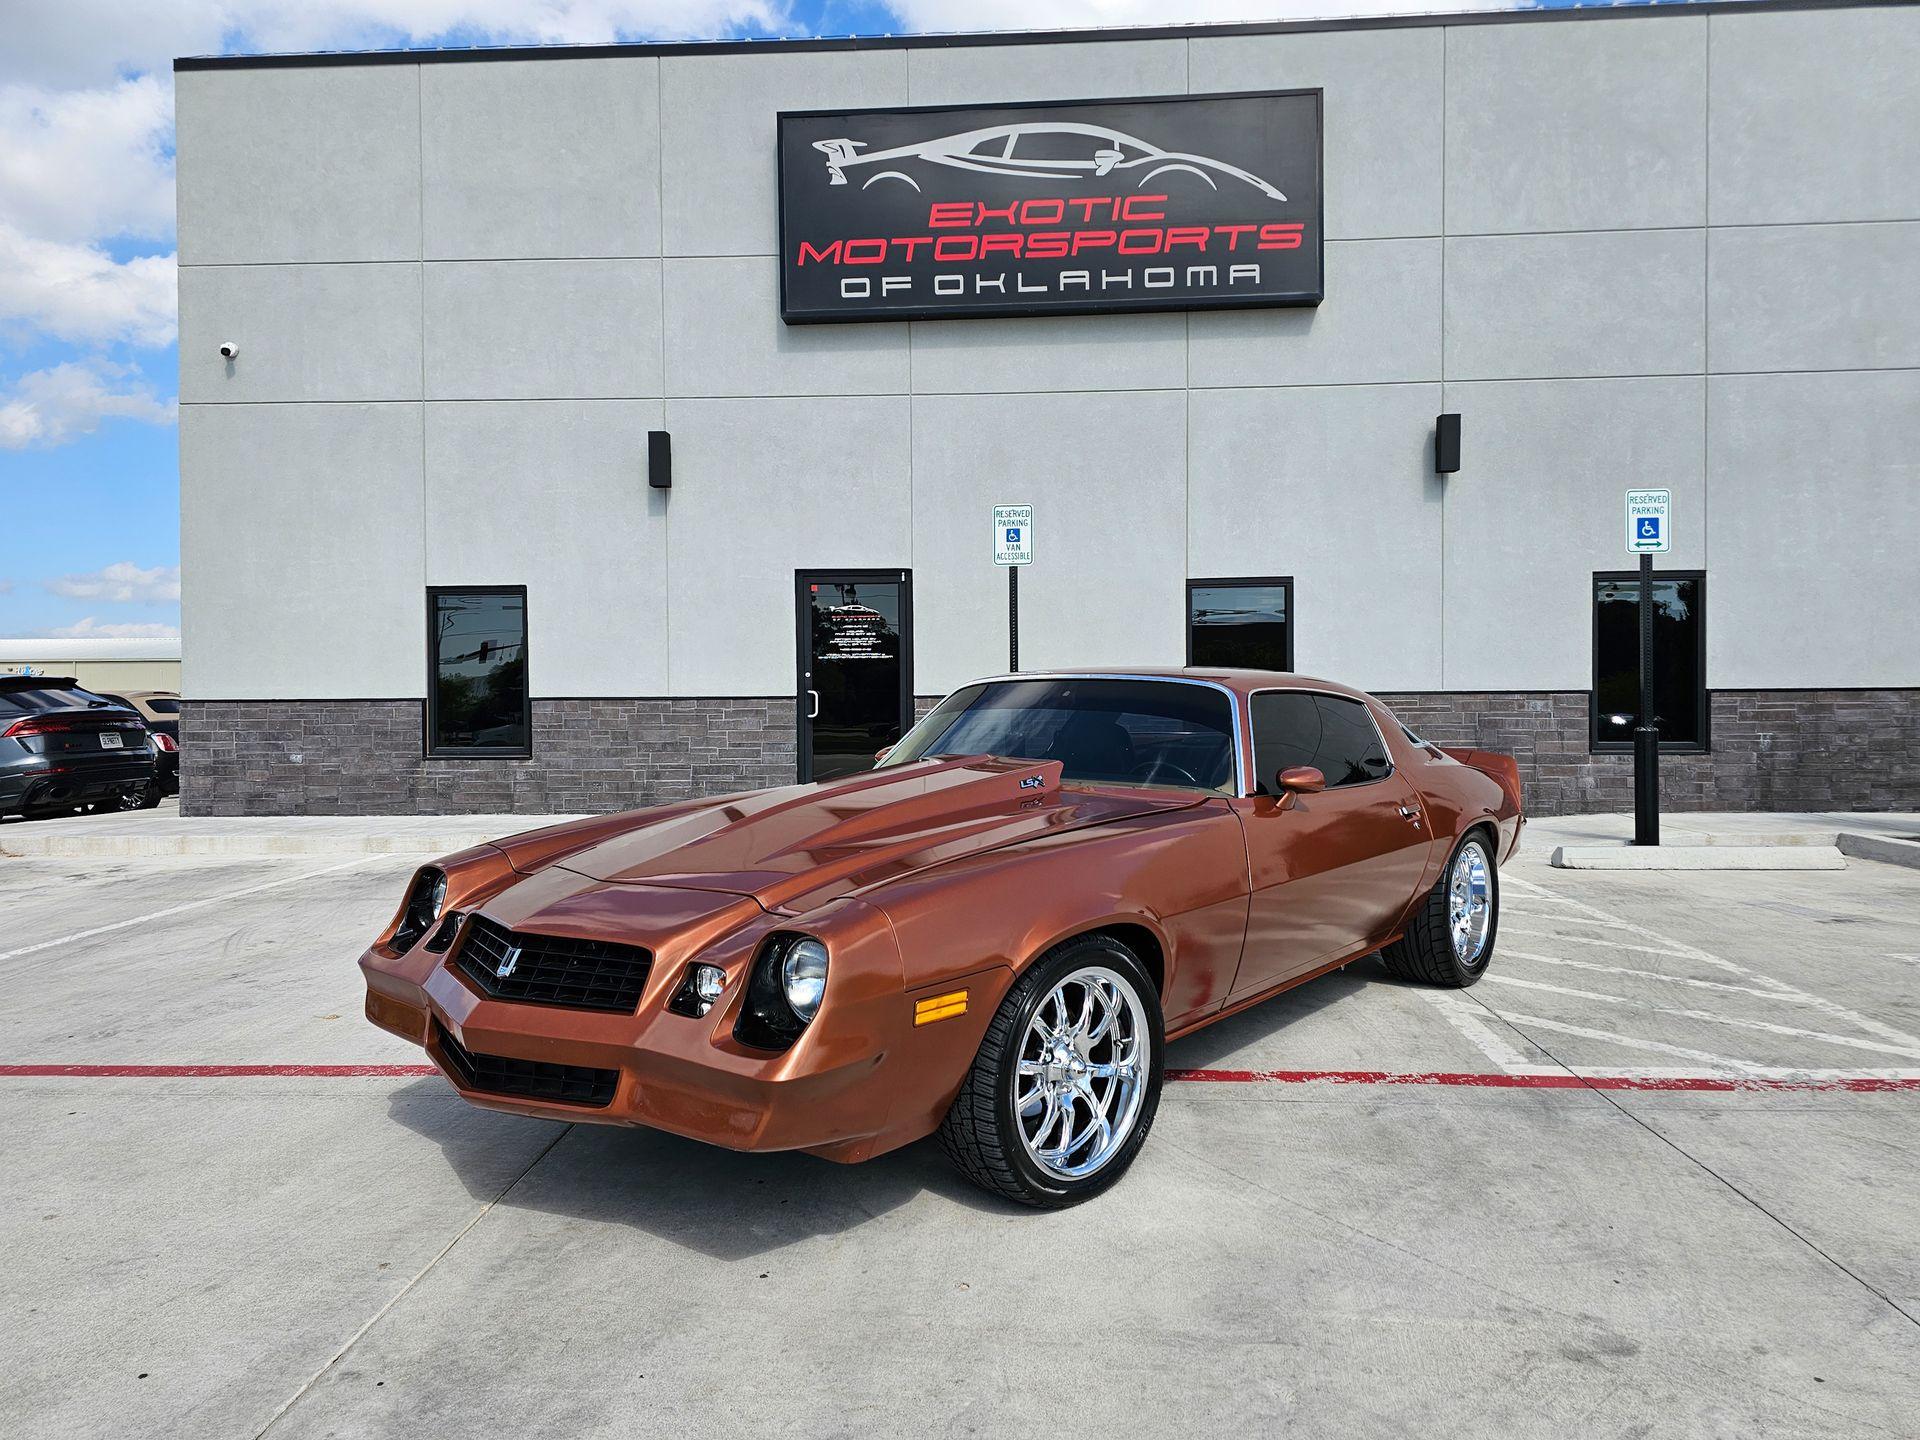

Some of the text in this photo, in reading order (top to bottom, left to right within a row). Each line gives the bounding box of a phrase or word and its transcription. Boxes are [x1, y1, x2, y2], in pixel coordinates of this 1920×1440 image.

[928, 194, 1168, 228] EXOTIC
[797, 223, 1305, 266] MOTORSPORTS
[840, 264, 1260, 298] OF OKLAHOMA
[1629, 495, 1668, 504] RESERVED
[995, 510, 1031, 518] RESERVED
[1631, 506, 1665, 515] PARKING
[997, 519, 1029, 527] PARKING
[996, 552, 1031, 560] ACCESSIBLE
